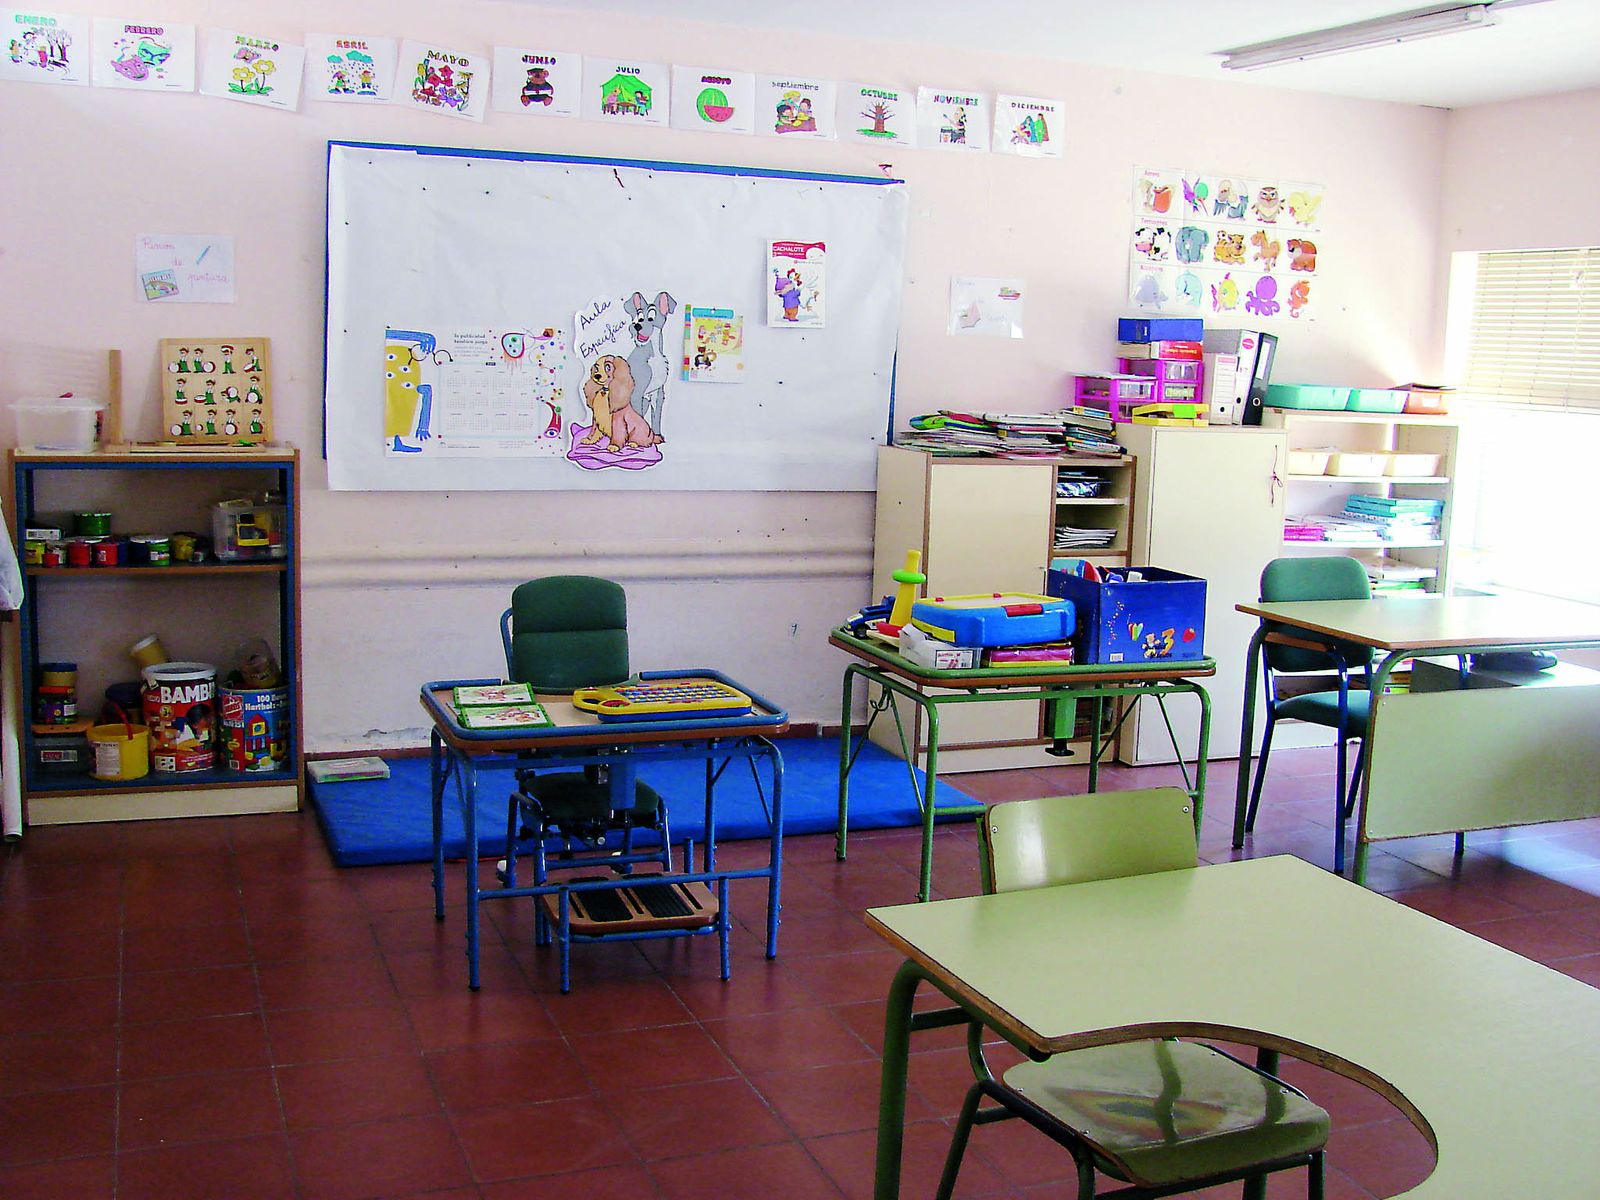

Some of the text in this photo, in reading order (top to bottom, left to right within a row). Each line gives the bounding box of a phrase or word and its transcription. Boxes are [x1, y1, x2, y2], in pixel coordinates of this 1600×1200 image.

[15, 14, 57, 26] ENERO
[124, 25, 164, 35] FEBRERO
[235, 35, 279, 52] MARZO
[336, 40, 368, 50] ABRIL
[427, 50, 469, 67] MAYO
[522, 55, 556, 65] JUNIO
[615, 66, 641, 75] JULIO
[771, 81, 819, 91] septiembre
[860, 88, 898, 101] OCTUBRE
[933, 95, 979, 106] NOVIEMBRE
[1011, 102, 1055, 112] DICIEMBRE
[772, 245, 805, 253] CACHALOTE
[580, 301, 611, 330] Aula
[1160, 628, 1175, 656] 3
[257, 695, 271, 703] 100
